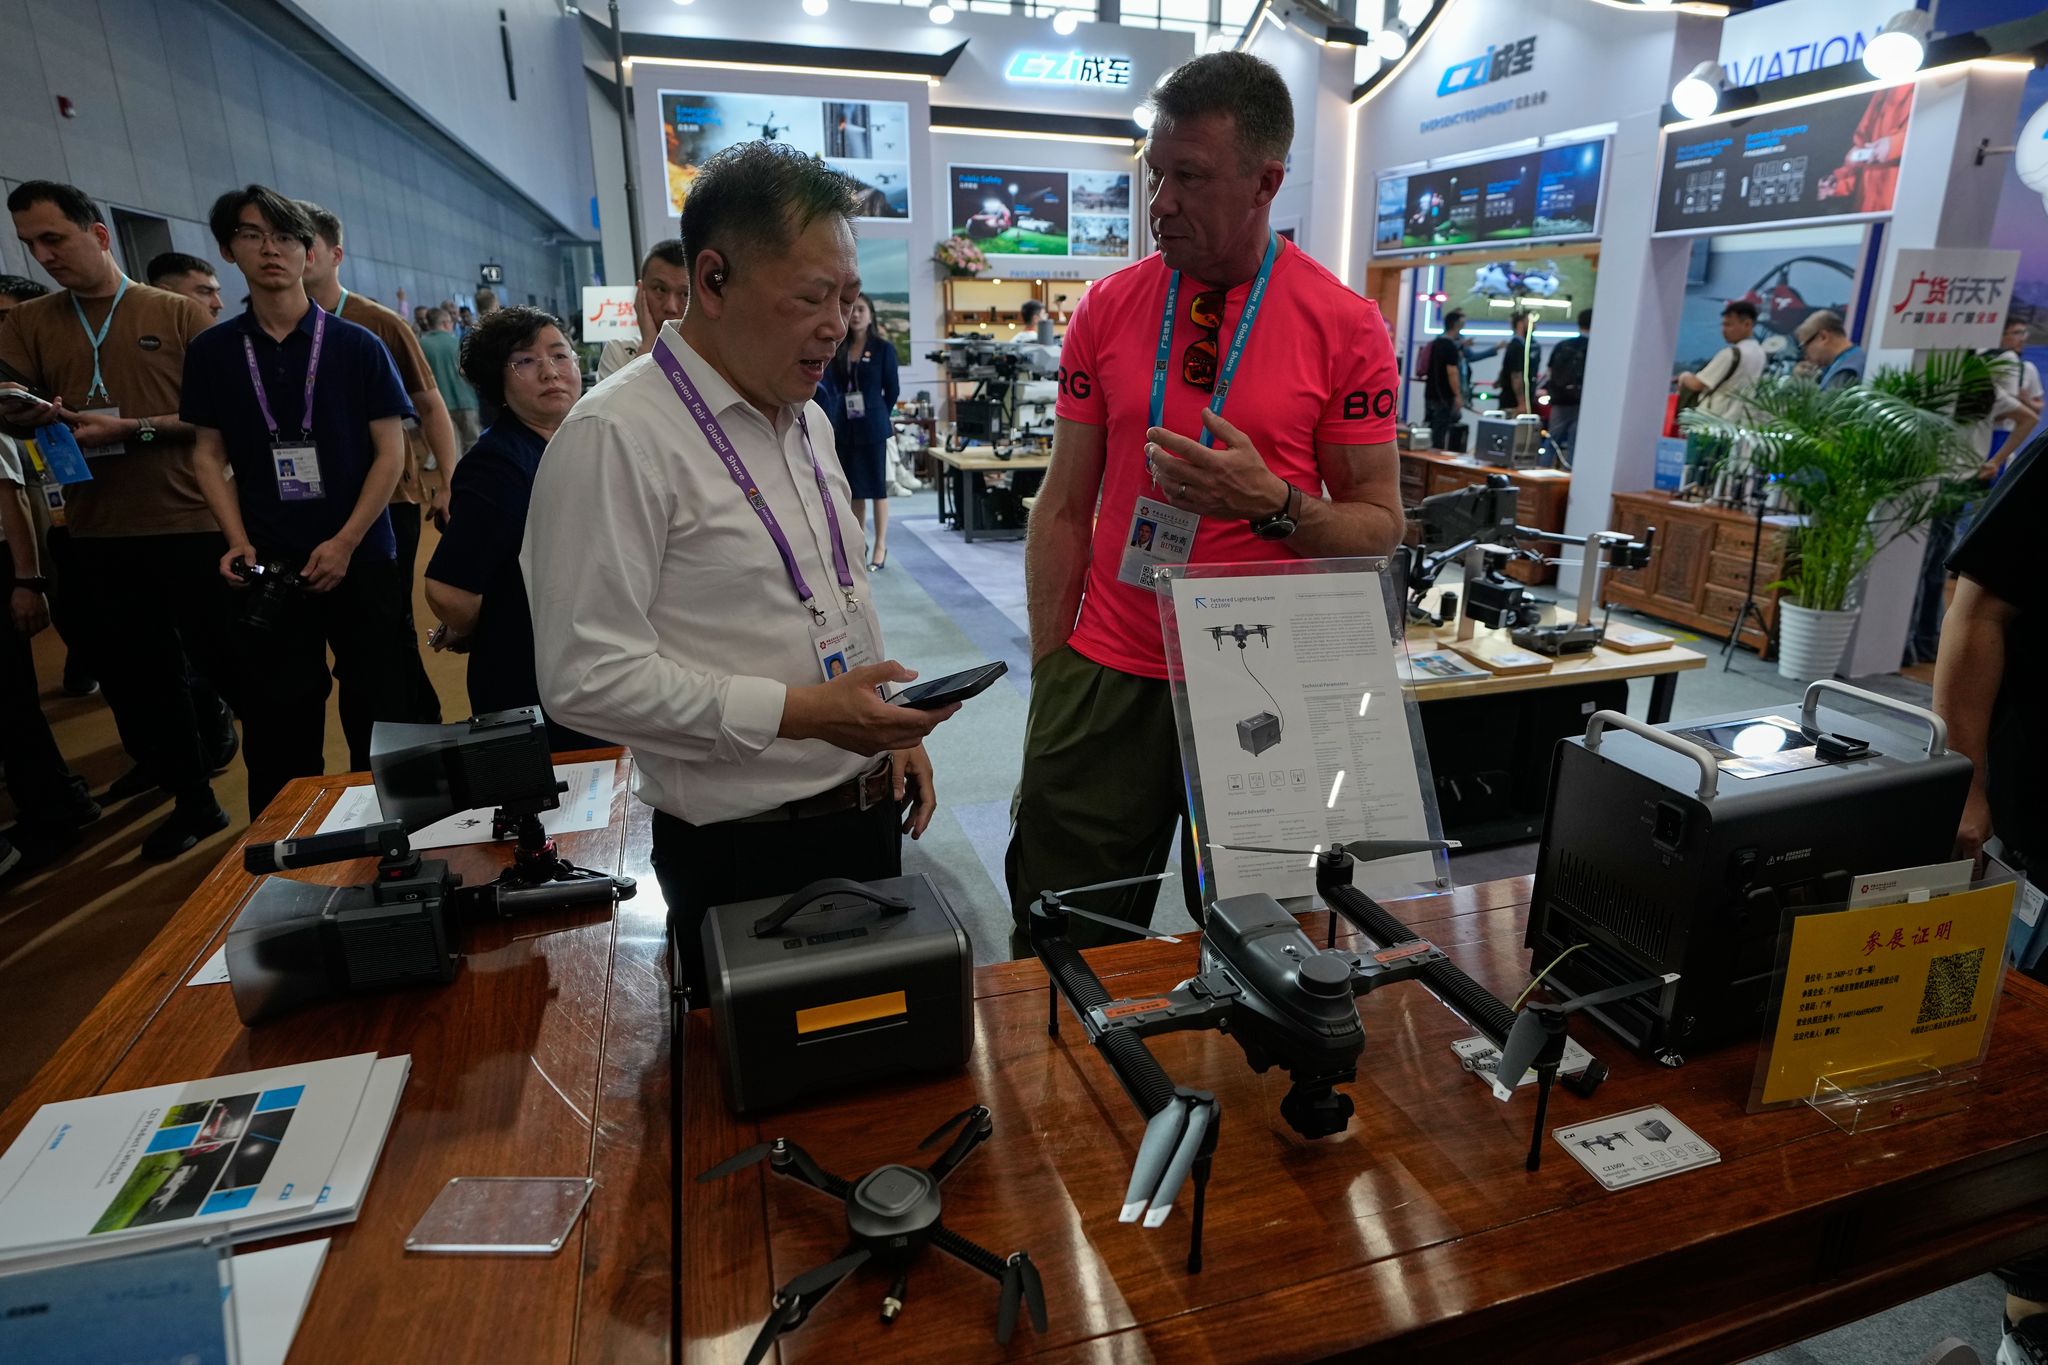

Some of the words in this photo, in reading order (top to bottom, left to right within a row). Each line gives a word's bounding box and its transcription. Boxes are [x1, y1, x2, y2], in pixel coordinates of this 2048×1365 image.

[1080, 57, 1130, 85] 成至
[1250, 277, 1265, 303] Canton
[1893, 271, 2006, 314] 广货行天下
[1244, 304, 1256, 320] Fair
[1235, 323, 1249, 349] Global
[1225, 351, 1239, 372] Share
[672, 370, 693, 401] Canton
[692, 402, 707, 421] Fair
[706, 423, 729, 453] Global
[726, 455, 745, 482] Share
[1160, 542, 1183, 554] BUYER
[1861, 920, 1953, 957] 参展证明
[130, 1119, 154, 1148] Product
